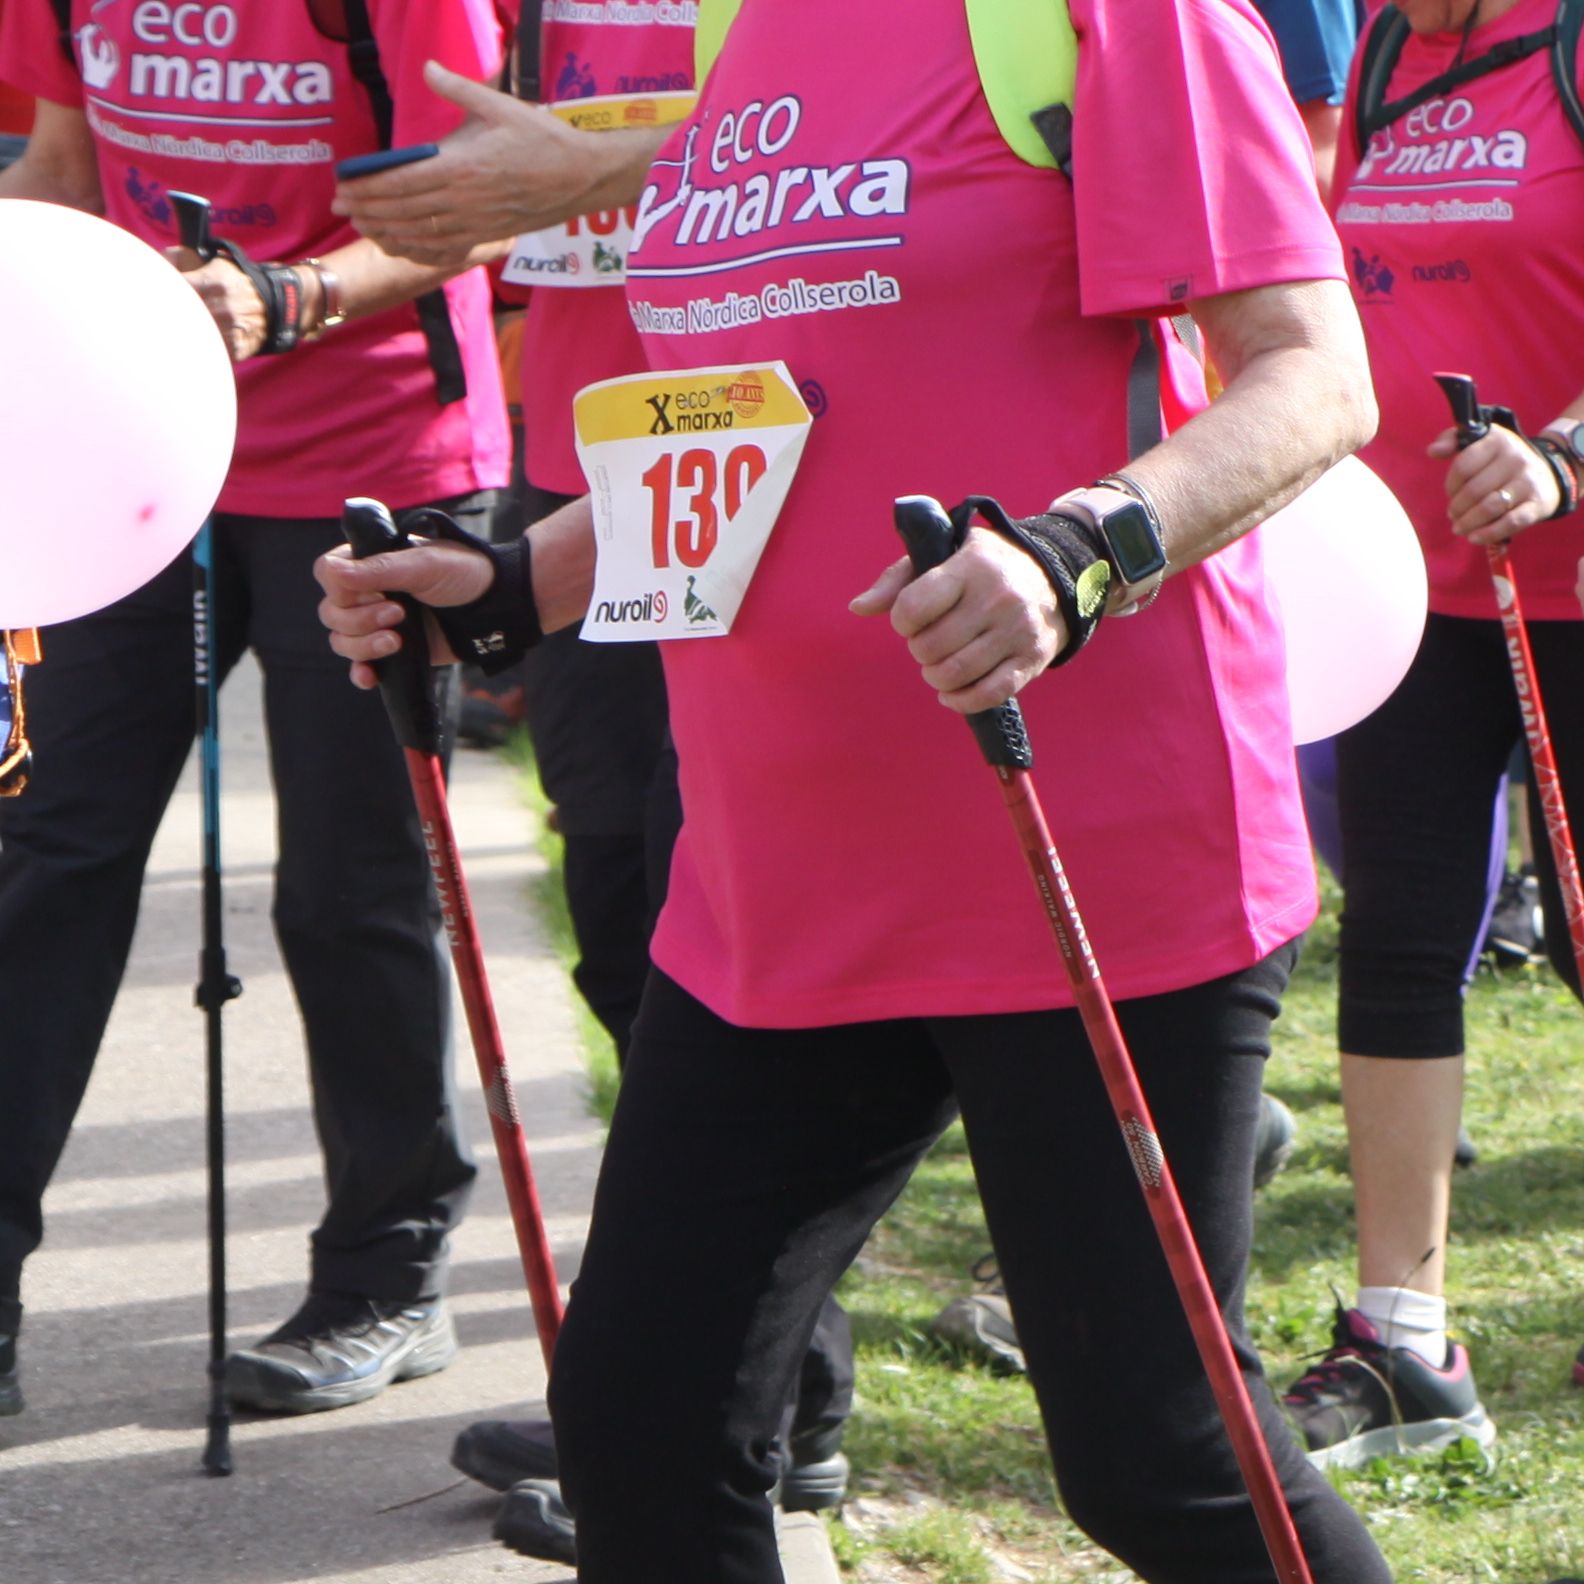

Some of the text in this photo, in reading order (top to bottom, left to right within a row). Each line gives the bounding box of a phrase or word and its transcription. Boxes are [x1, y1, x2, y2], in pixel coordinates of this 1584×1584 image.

[130, 52, 333, 105] marxa
[710, 94, 802, 173] eco
[1405, 98, 1474, 138] eco
[1384, 129, 1528, 176] marxa
[674, 157, 910, 247] marxa
[513, 254, 567, 273] nuroil
[640, 300, 686, 334] Marxa
[687, 292, 761, 334] Nòrdica
[761, 270, 902, 318] Collserola
[645, 390, 711, 436] X eco
[676, 410, 734, 432] marxa
[594, 593, 653, 624] nuroil
[422, 820, 460, 947] NEWFEEL
[1037, 874, 1073, 959] NORDIC WALKING
